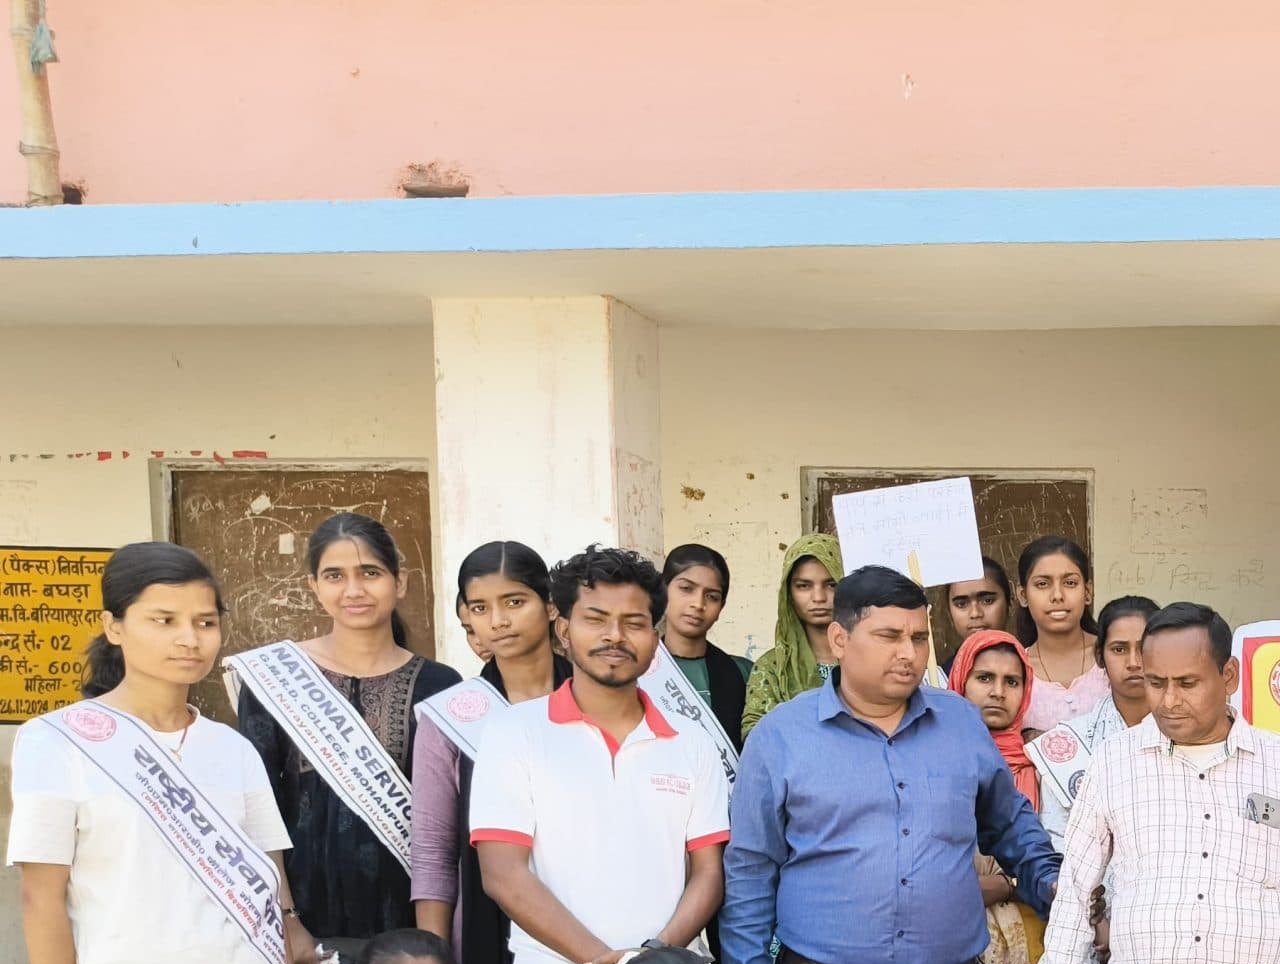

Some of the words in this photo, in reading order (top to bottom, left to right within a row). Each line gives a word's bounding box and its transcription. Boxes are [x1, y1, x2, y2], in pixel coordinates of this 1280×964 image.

[51, 636, 71, 651] 02
[258, 653, 299, 703] G.M.R.D.
[300, 704, 349, 766] COLLEGE,
[351, 767, 409, 839] MOHANPUR
[272, 647, 355, 743] NATIONAL
[355, 745, 412, 822] SERVIC
[276, 693, 319, 746] Narayan
[319, 746, 356, 793] Mithila
[133, 744, 217, 836] राष्ट्रीय
[215, 836, 270, 895] सेवा
